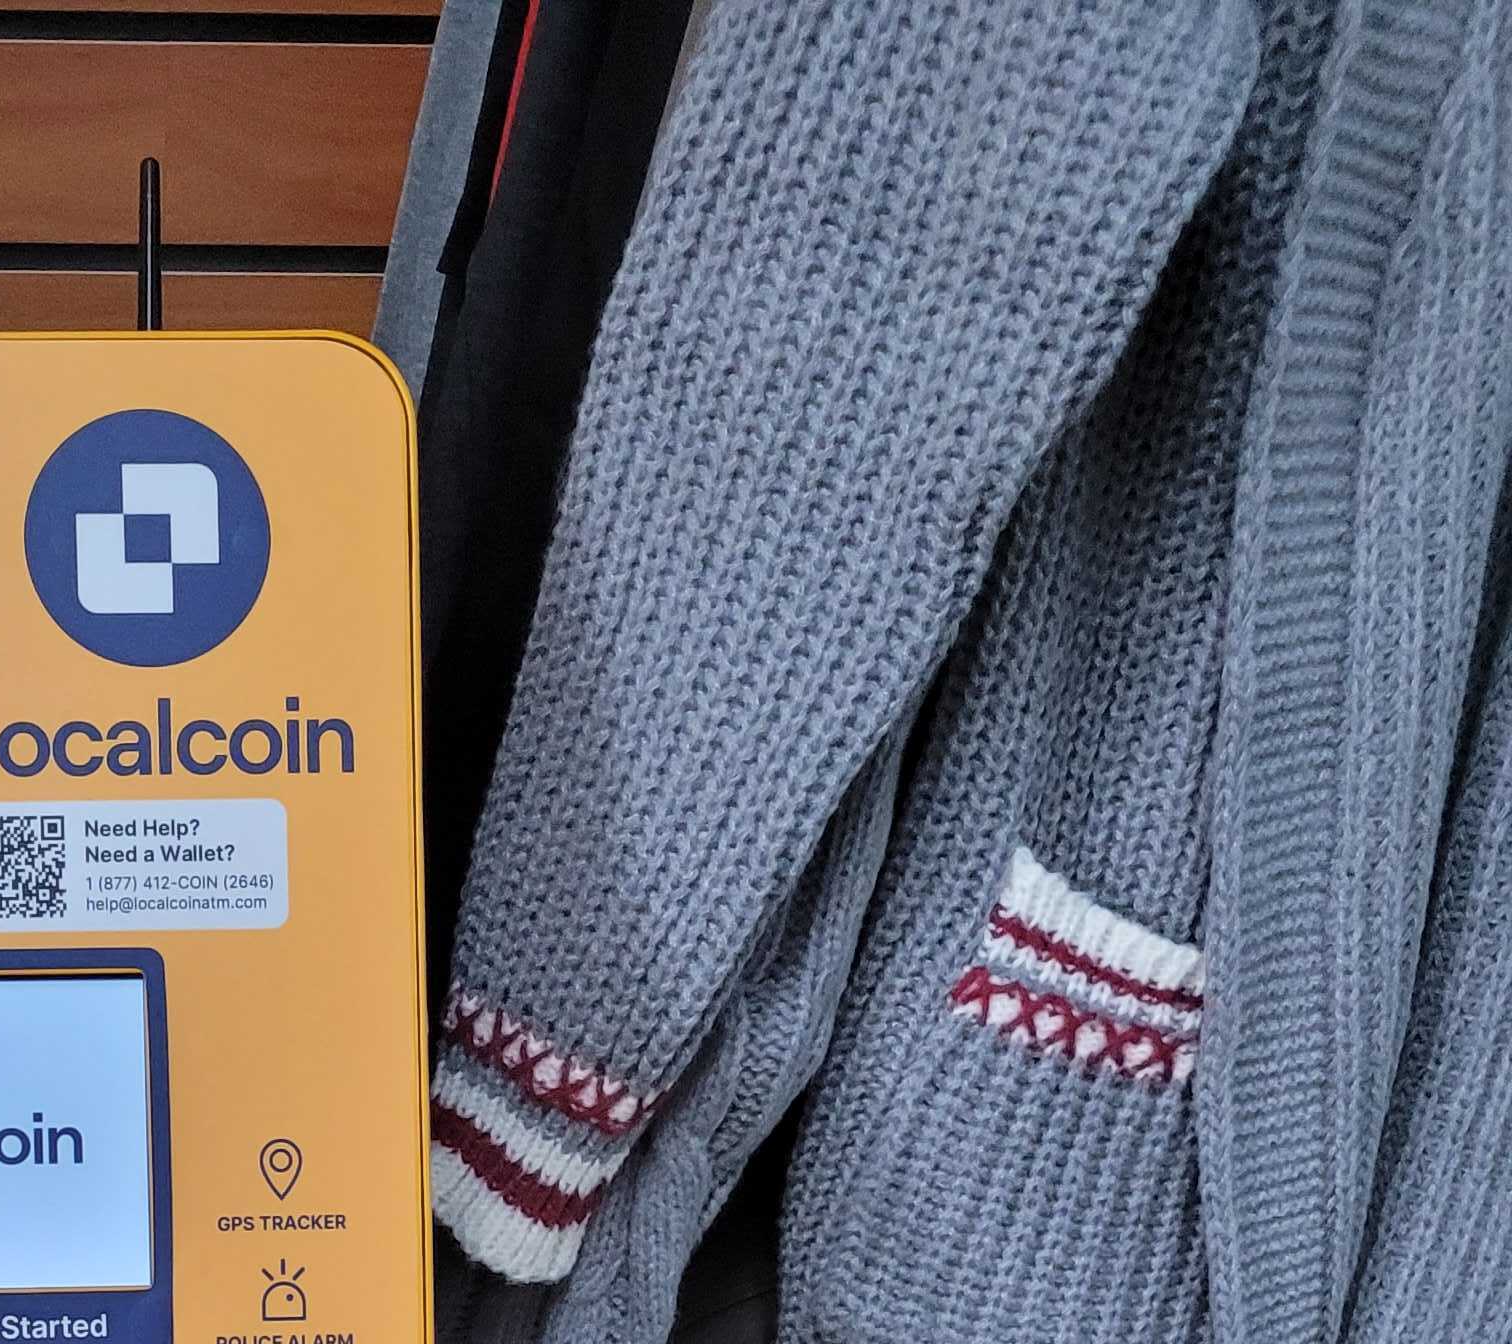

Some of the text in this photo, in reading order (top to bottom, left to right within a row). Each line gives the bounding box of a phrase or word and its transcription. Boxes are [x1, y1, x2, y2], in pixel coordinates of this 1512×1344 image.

[85, 819, 200, 840] Need Help?
[85, 845, 236, 863] Need a Wallet?
[86, 874, 274, 892] 1 (877) 412-COIN (2646)
[86, 896, 268, 913] help@localcoinatm.com
[217, 1214, 347, 1232] GPS TRACKER
[1, 1314, 108, 1341] Started
